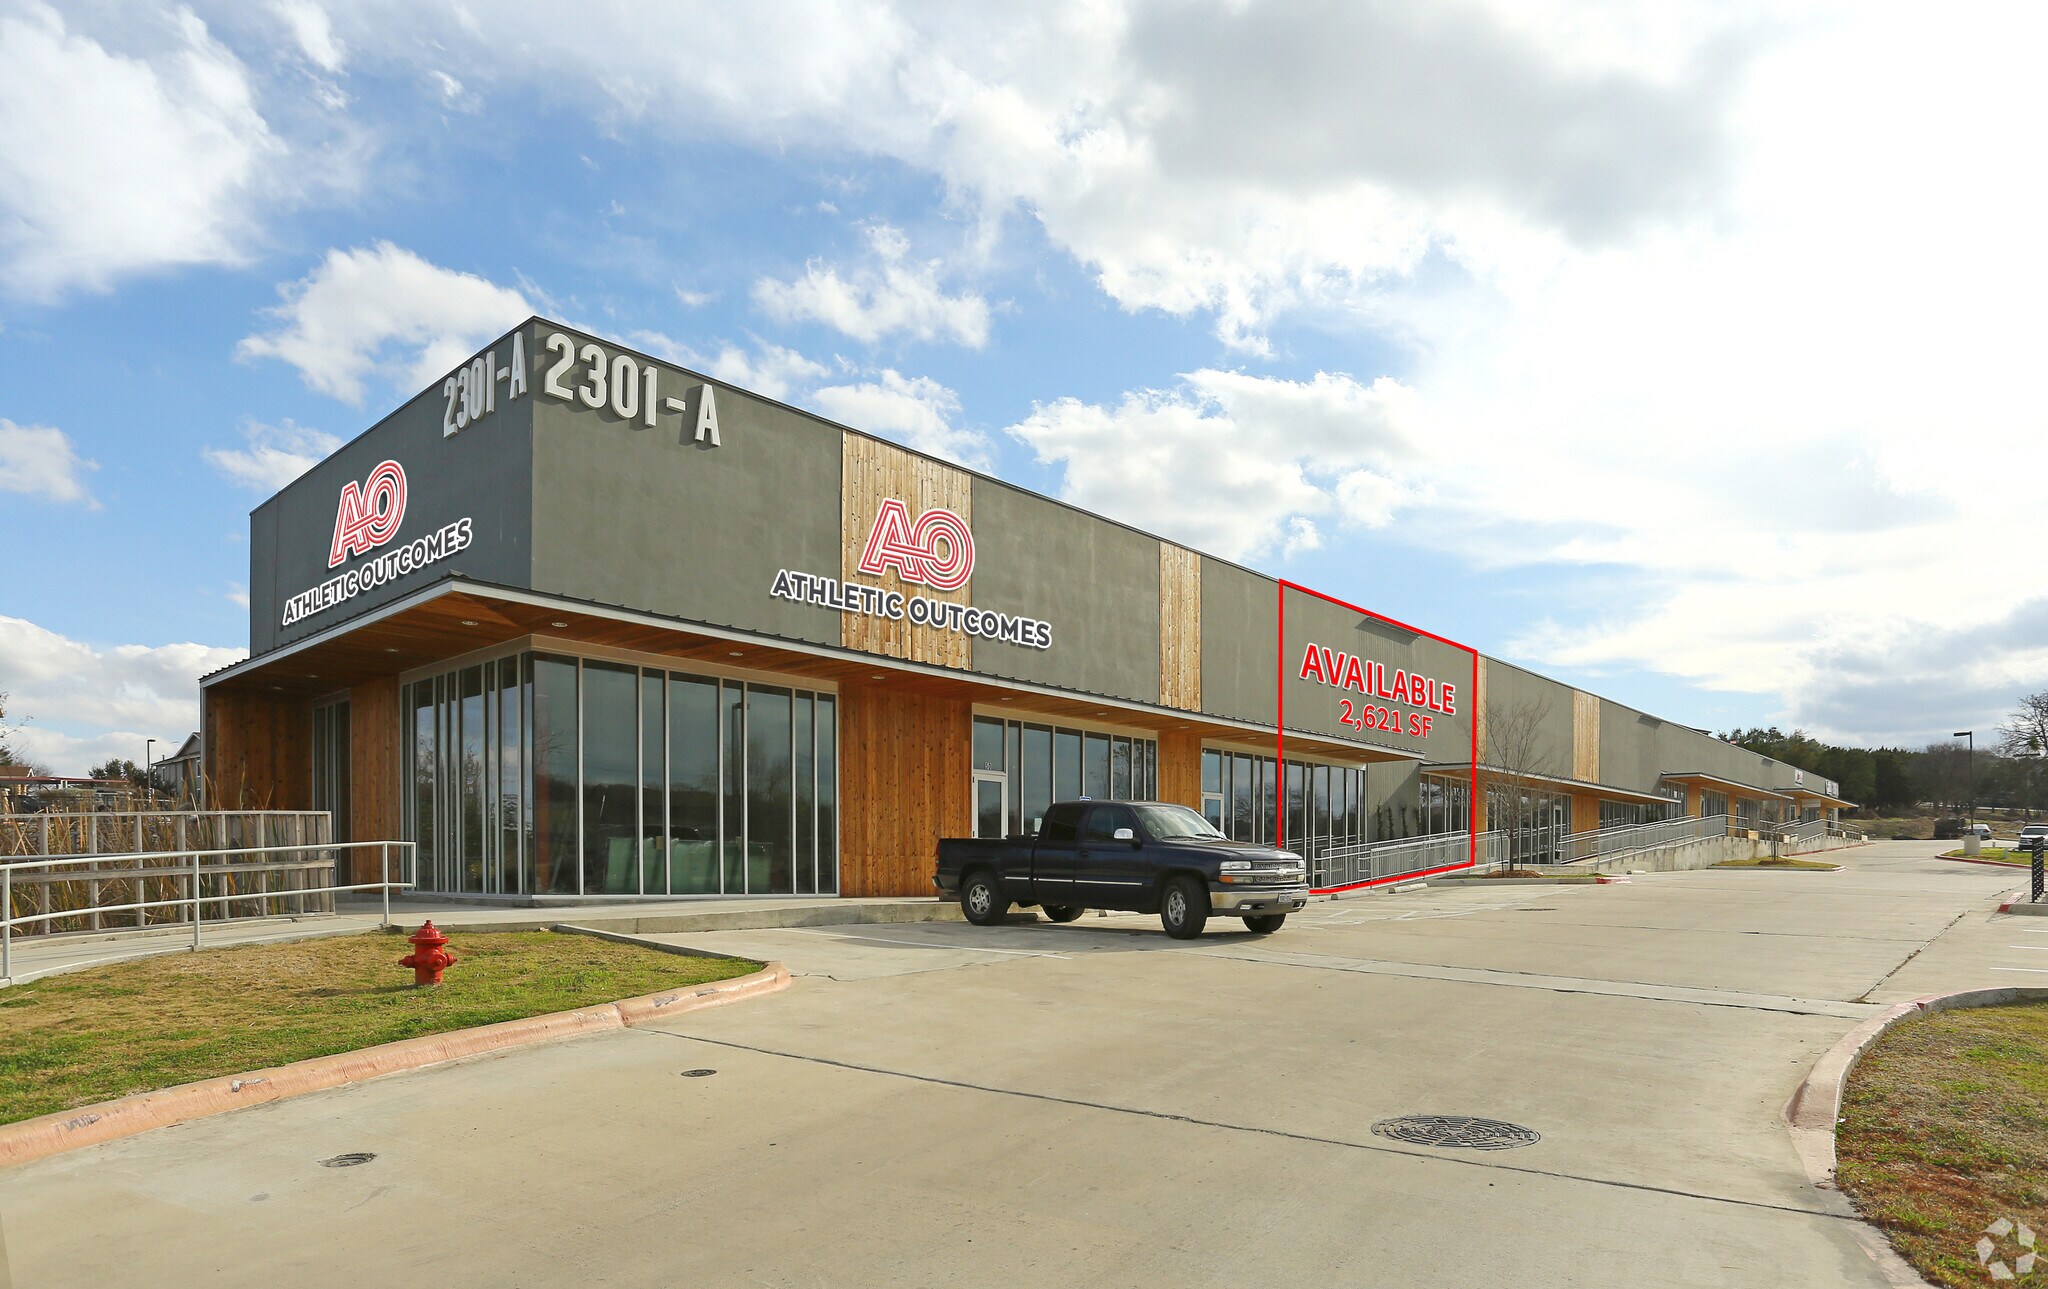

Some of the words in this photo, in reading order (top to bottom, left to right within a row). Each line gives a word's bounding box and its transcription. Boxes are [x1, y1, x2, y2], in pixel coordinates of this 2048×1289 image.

[443, 332, 527, 438] 2301-A
[545, 333, 721, 446] 2301-A
[329, 460, 407, 568] AO
[858, 499, 976, 591] AO
[282, 570, 358, 626] ATHLETIC
[359, 517, 473, 591] OUTCOMES
[770, 569, 905, 620] ATHLETIC
[907, 595, 1053, 649] OUTCOMES
